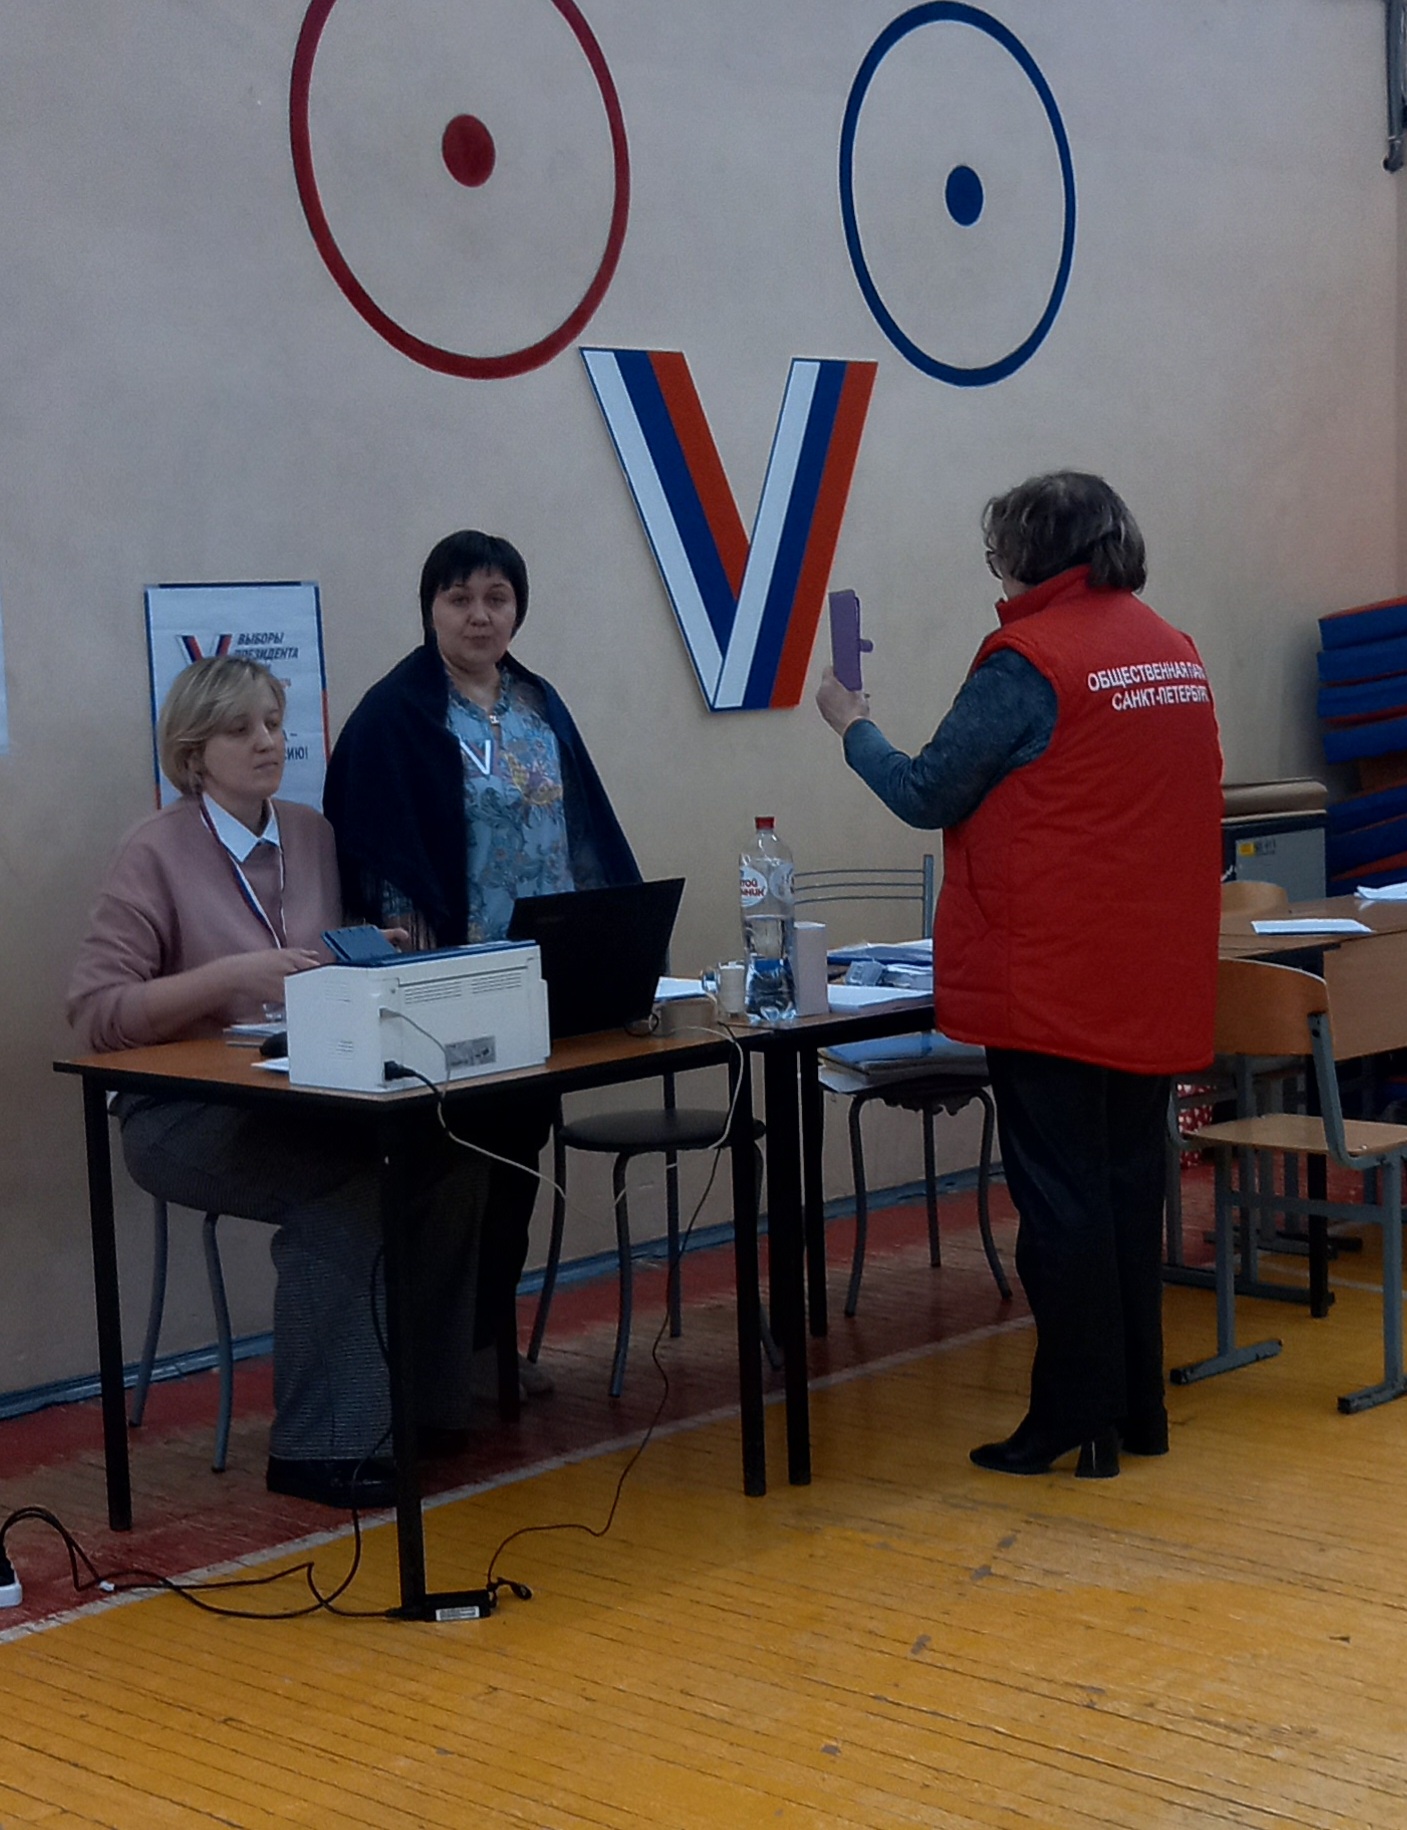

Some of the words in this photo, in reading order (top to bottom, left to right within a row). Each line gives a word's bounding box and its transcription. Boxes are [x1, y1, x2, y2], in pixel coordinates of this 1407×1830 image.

[237, 632, 285, 645] ВЫБОРЫ
[1087, 661, 1189, 692] ОБЩЕСТВЕННАЯ
[285, 745, 308, 760] ИЮ!
